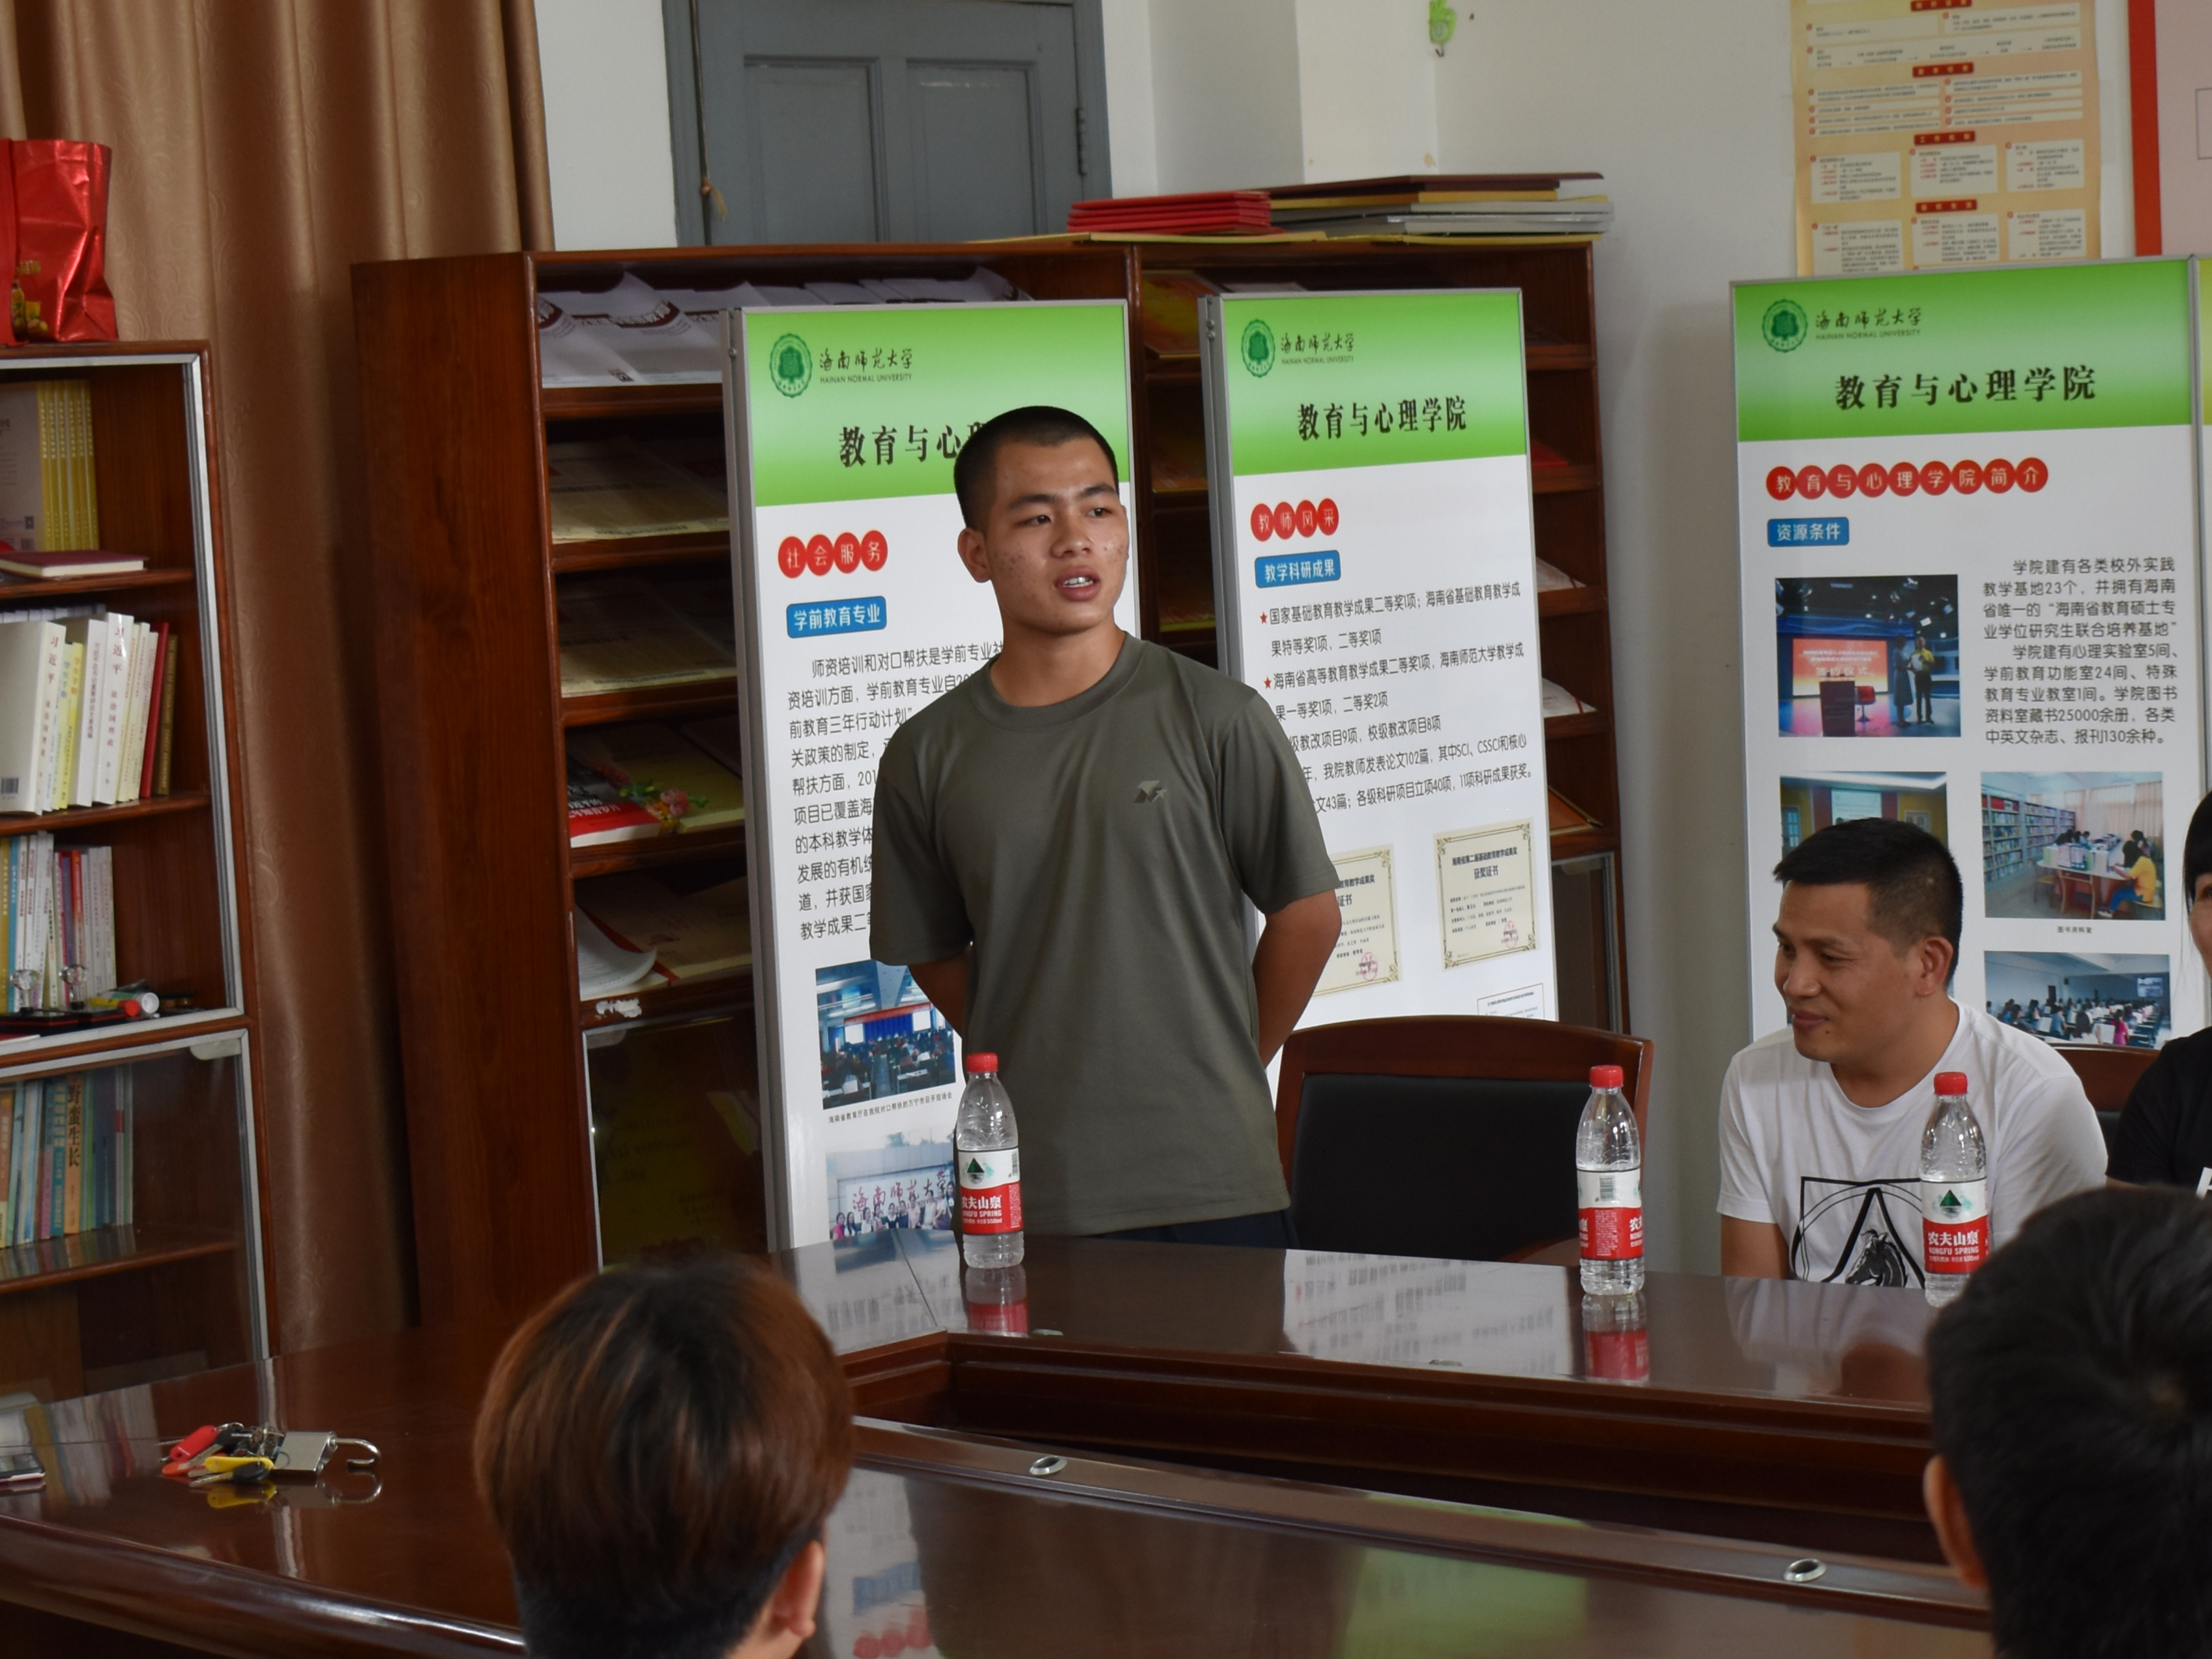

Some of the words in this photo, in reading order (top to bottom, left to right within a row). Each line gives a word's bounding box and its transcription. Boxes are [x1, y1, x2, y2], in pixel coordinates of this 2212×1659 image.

[1816, 307, 1921, 330] 海南师范大学
[1281, 332, 1354, 355] 海南师范大学
[1879, 329, 1920, 338] UNIVERSITY
[820, 347, 912, 372] 海南师范大学
[848, 374, 875, 383] NORMAL
[877, 373, 912, 382] UNIVERSITY
[1836, 364, 2096, 411] 教育与心理学院
[1297, 396, 1466, 441] 教育与心理学院
[1775, 467, 2039, 492] 教育与心理学院简介
[1259, 508, 1335, 533] 教师风采
[1777, 523, 1841, 541] 资源条件
[786, 540, 882, 569] 社会服务
[2013, 557, 2175, 575] 学院建有各类校外实践
[1264, 558, 1335, 583] 教学科研成果
[794, 603, 880, 631] 学前教育专业
[788, 673, 972, 711] 资培训方面，学前教育专业自20
[791, 737, 891, 768] 关政策的制定，
[1313, 763, 1532, 814] 文43篇；各级科研项目立项40项，11项科研成果获奖。
[794, 797, 875, 825] 项目已覆盖海
[796, 825, 873, 854] 的本科教学体
[68, 1085, 82, 1167] 野蛮生长
[1928, 1231, 1979, 1246] 农夫山泉
[1955, 1246, 1979, 1255] SPRING
